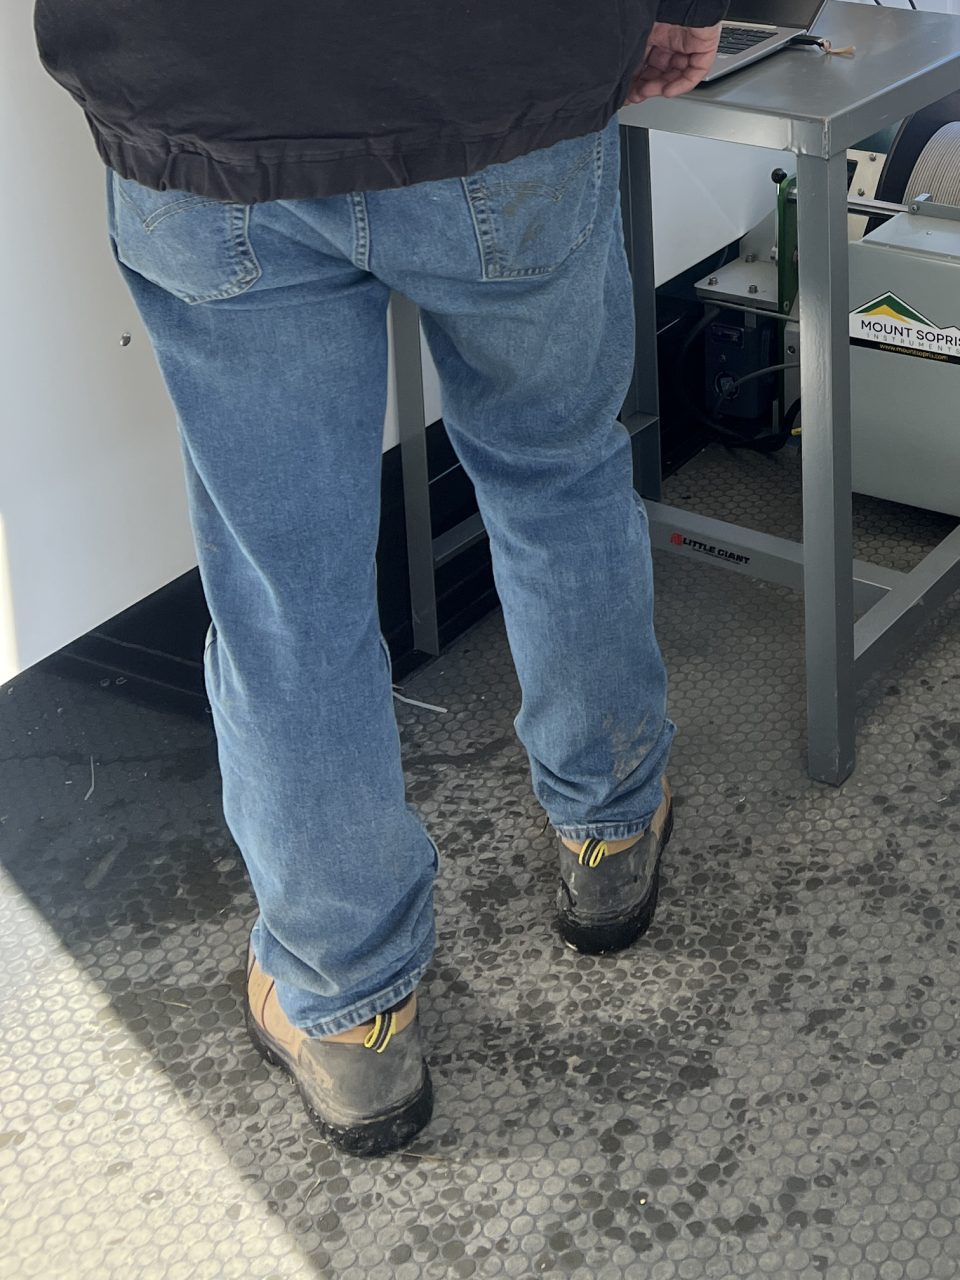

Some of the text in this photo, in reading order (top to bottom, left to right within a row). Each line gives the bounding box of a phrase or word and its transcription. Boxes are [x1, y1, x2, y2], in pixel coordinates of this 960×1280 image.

[861, 319, 912, 338] MOUNT
[866, 333, 960, 355] INSTRUMENTS
[683, 537, 716, 554] LITTLE
[717, 548, 750, 564] GIANT
